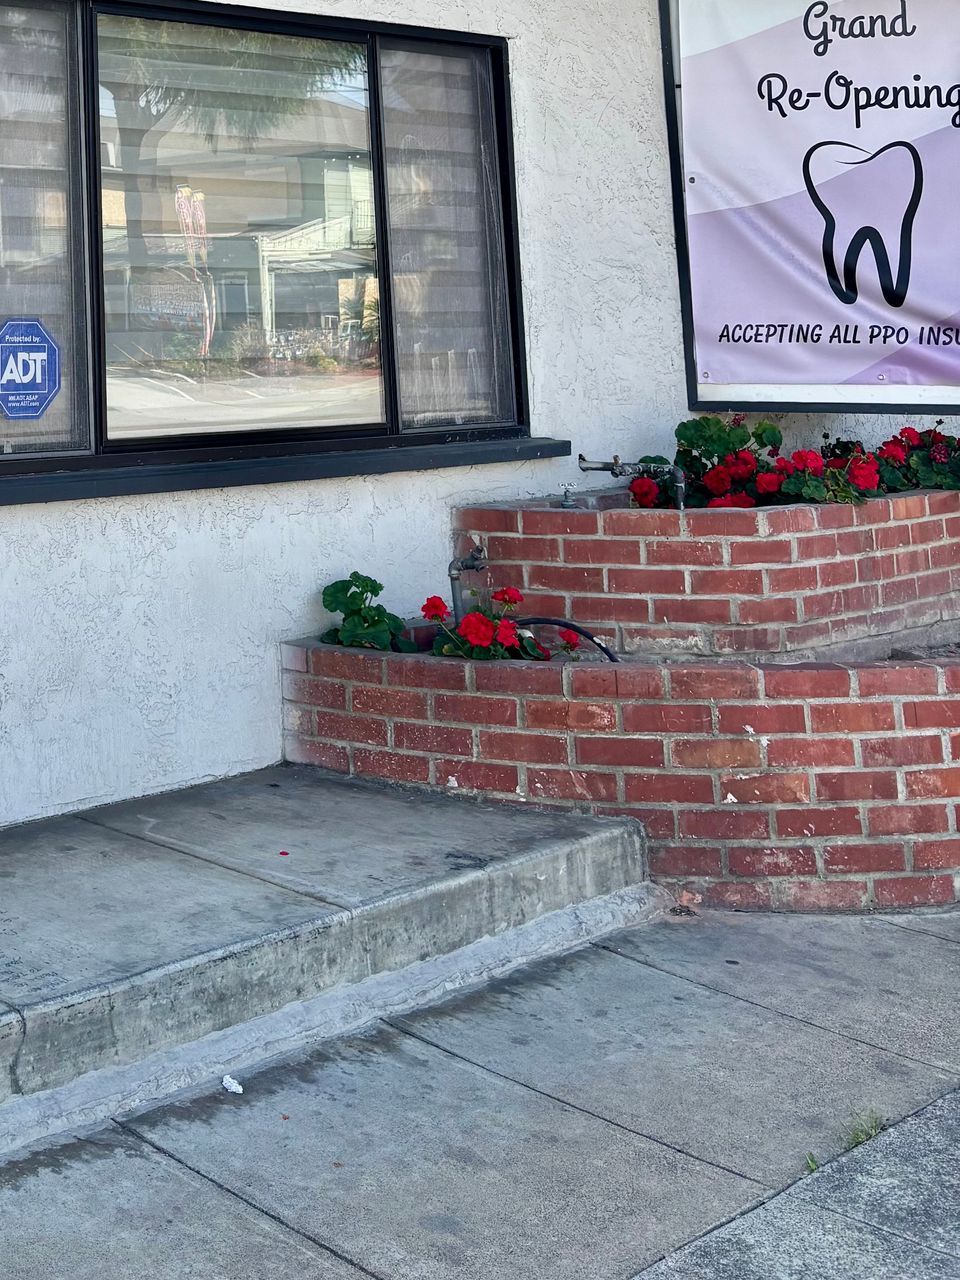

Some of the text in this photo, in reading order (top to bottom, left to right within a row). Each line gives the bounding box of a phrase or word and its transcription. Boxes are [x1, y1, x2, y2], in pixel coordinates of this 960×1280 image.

[803, 0, 917, 57] Grand
[757, 70, 960, 129] Re-Opening
[32, 335, 41, 343] by:
[718, 322, 823, 344] ACCEPTING
[828, 323, 861, 344] ALL
[868, 324, 909, 345] PPO
[0, 352, 47, 384] ADT
